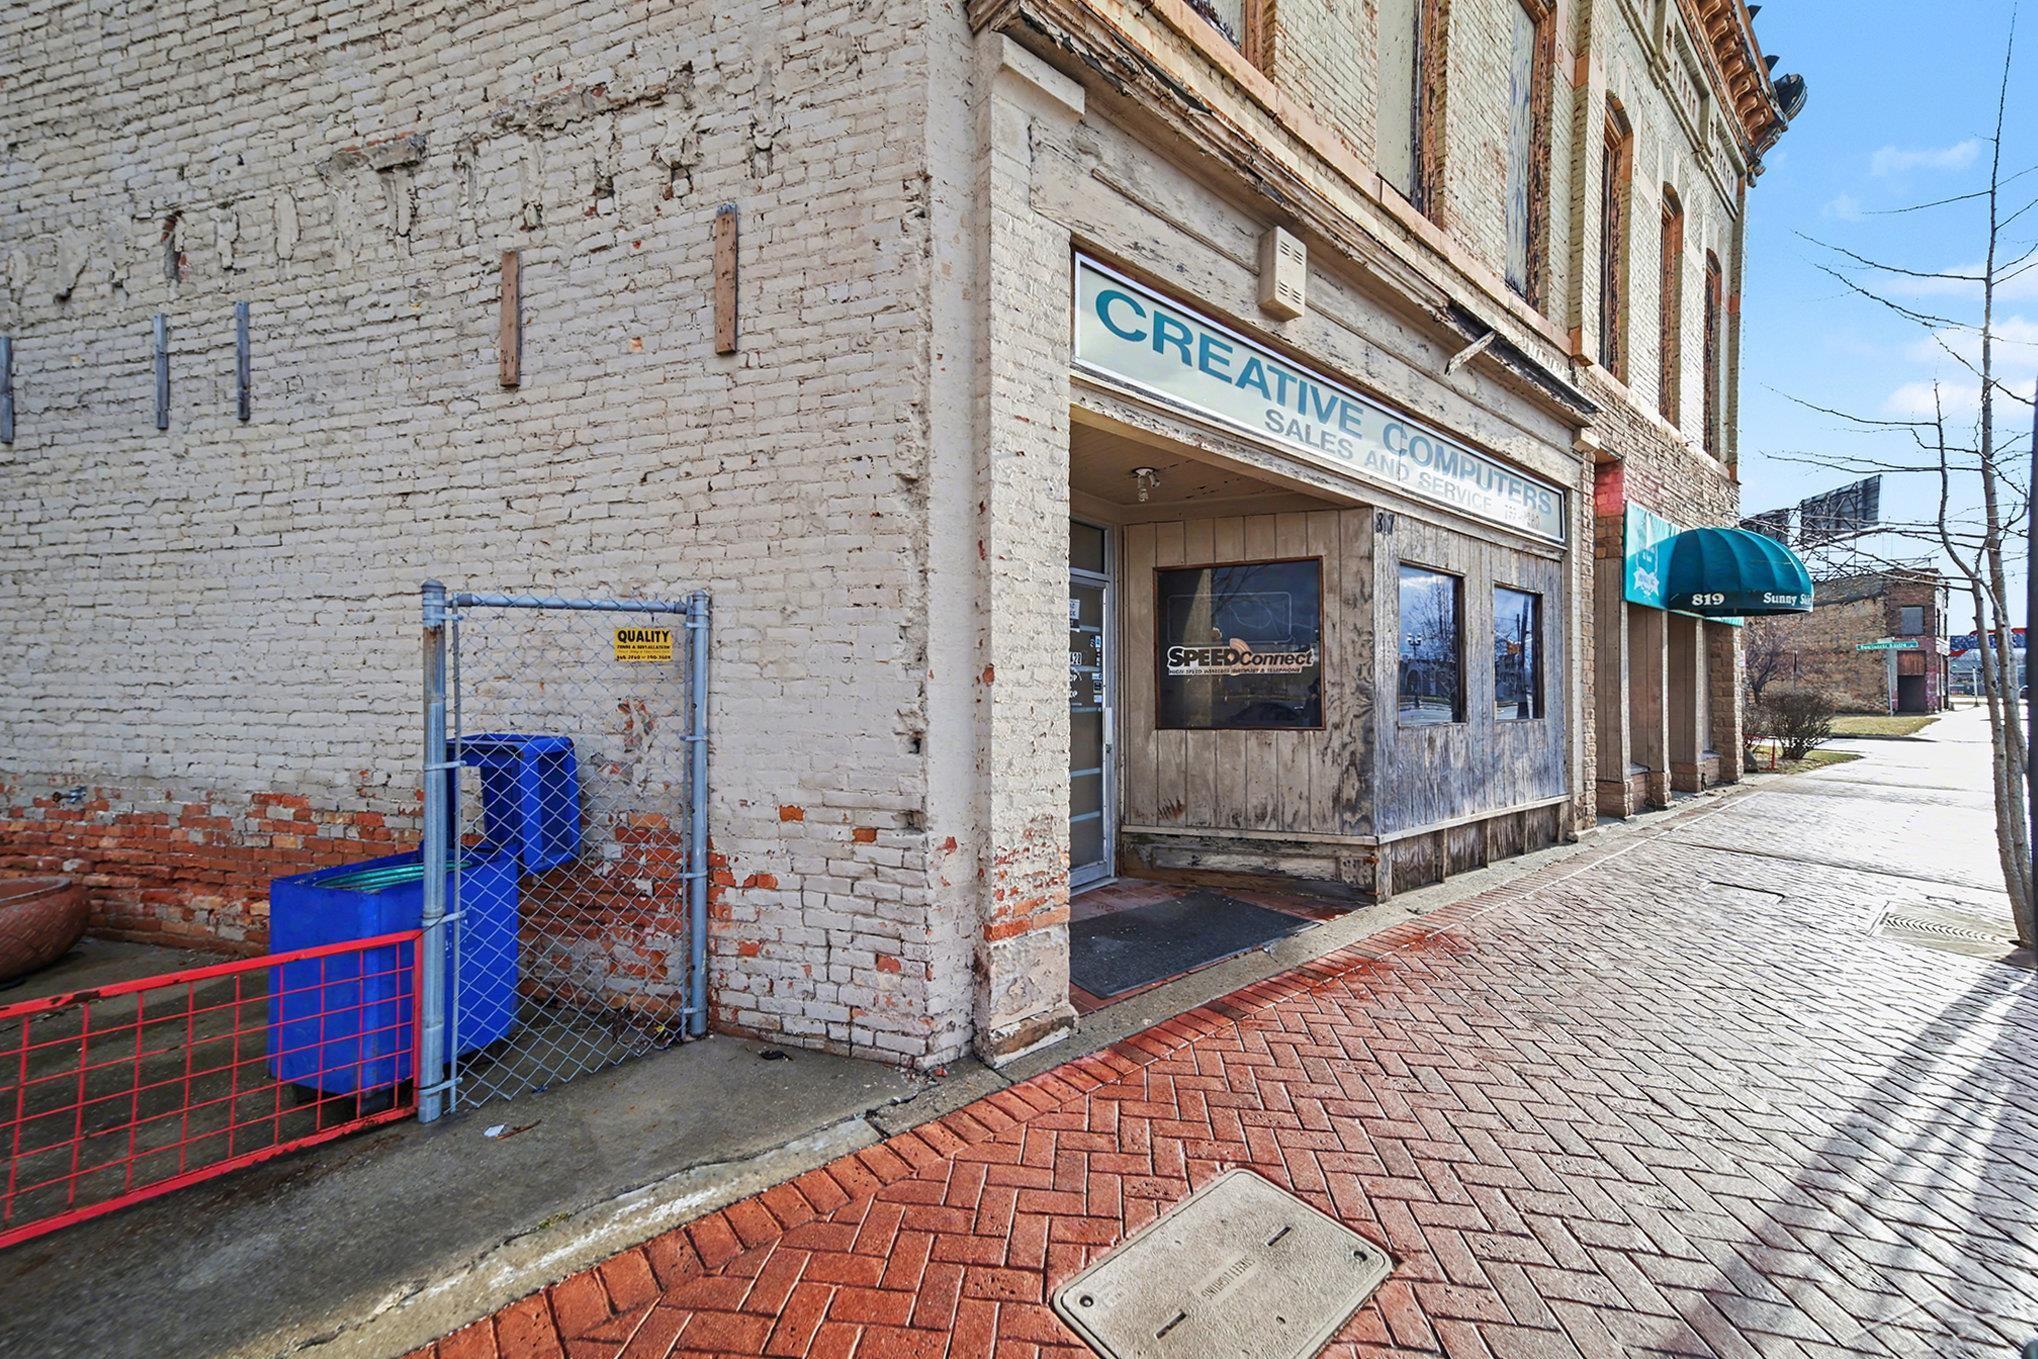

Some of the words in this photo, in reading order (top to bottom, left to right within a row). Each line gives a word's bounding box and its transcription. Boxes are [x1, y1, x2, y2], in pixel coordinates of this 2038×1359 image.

[1095, 289, 1365, 440] CREATIVE
[1382, 422, 1552, 515] COMPUTERS
[1264, 408, 1355, 461] SALES
[1364, 450, 1410, 482] AND
[1418, 471, 1494, 511] SERVICE
[1691, 593, 1725, 606] 819
[1763, 592, 1798, 606] Sunny
[617, 630, 670, 643] QUALITY
